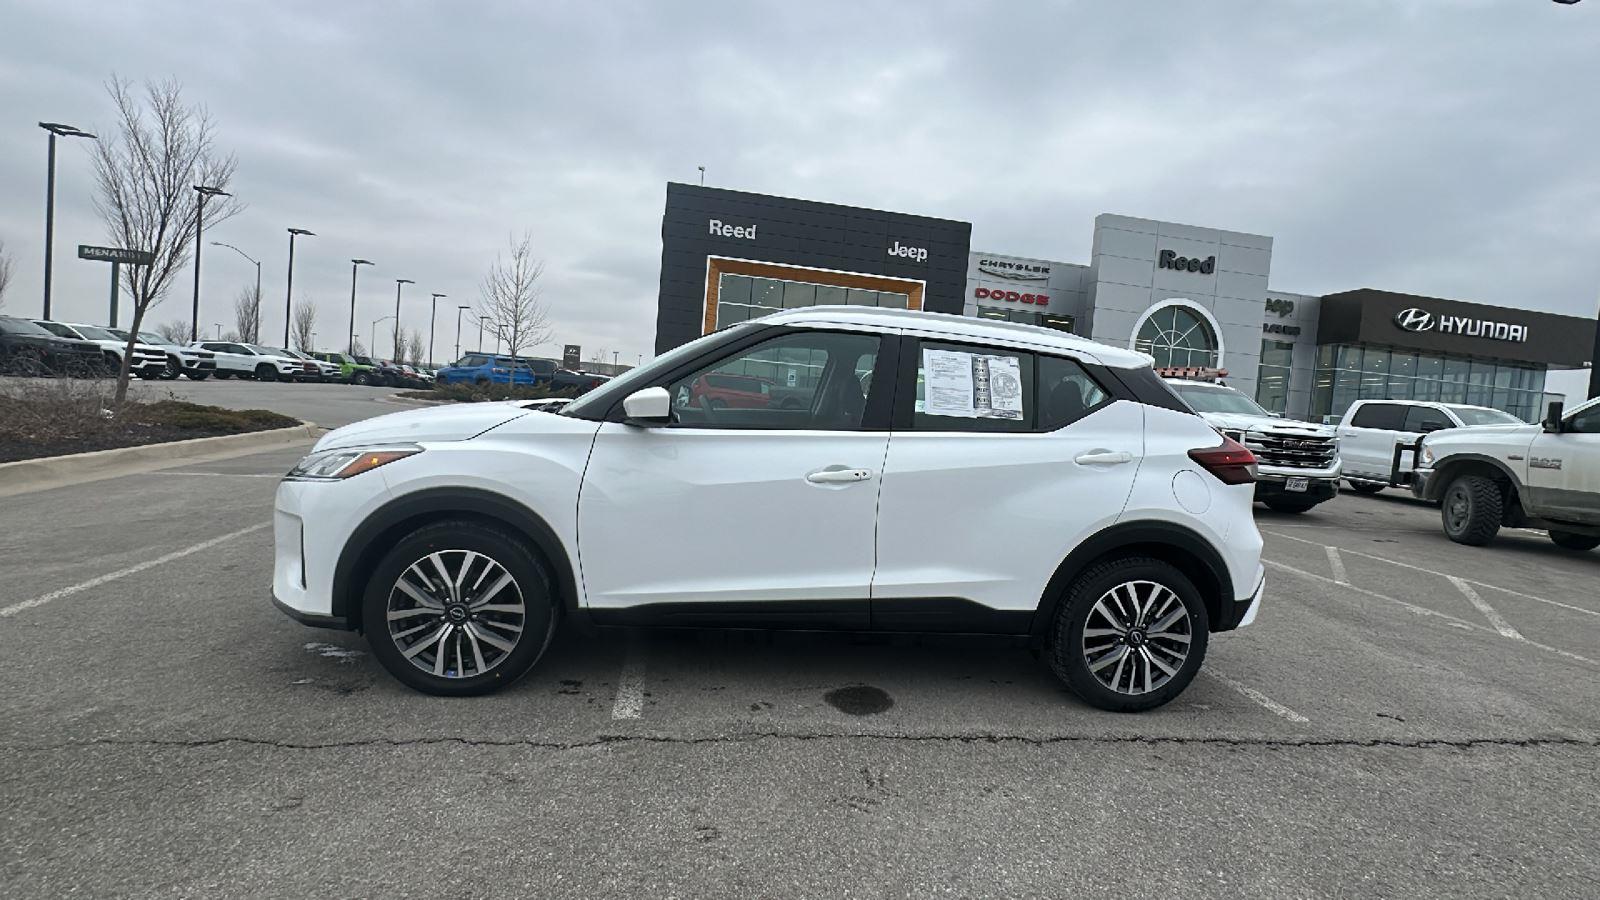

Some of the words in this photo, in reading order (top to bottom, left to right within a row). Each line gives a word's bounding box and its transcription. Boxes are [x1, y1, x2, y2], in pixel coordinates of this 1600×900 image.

[709, 219, 757, 240] Reed
[887, 241, 928, 262] Jeep
[1159, 249, 1216, 275] Reed
[979, 259, 1051, 274] CHRYSLER
[975, 287, 1051, 306] DODGE
[1439, 314, 1528, 343] HYUNDAI
